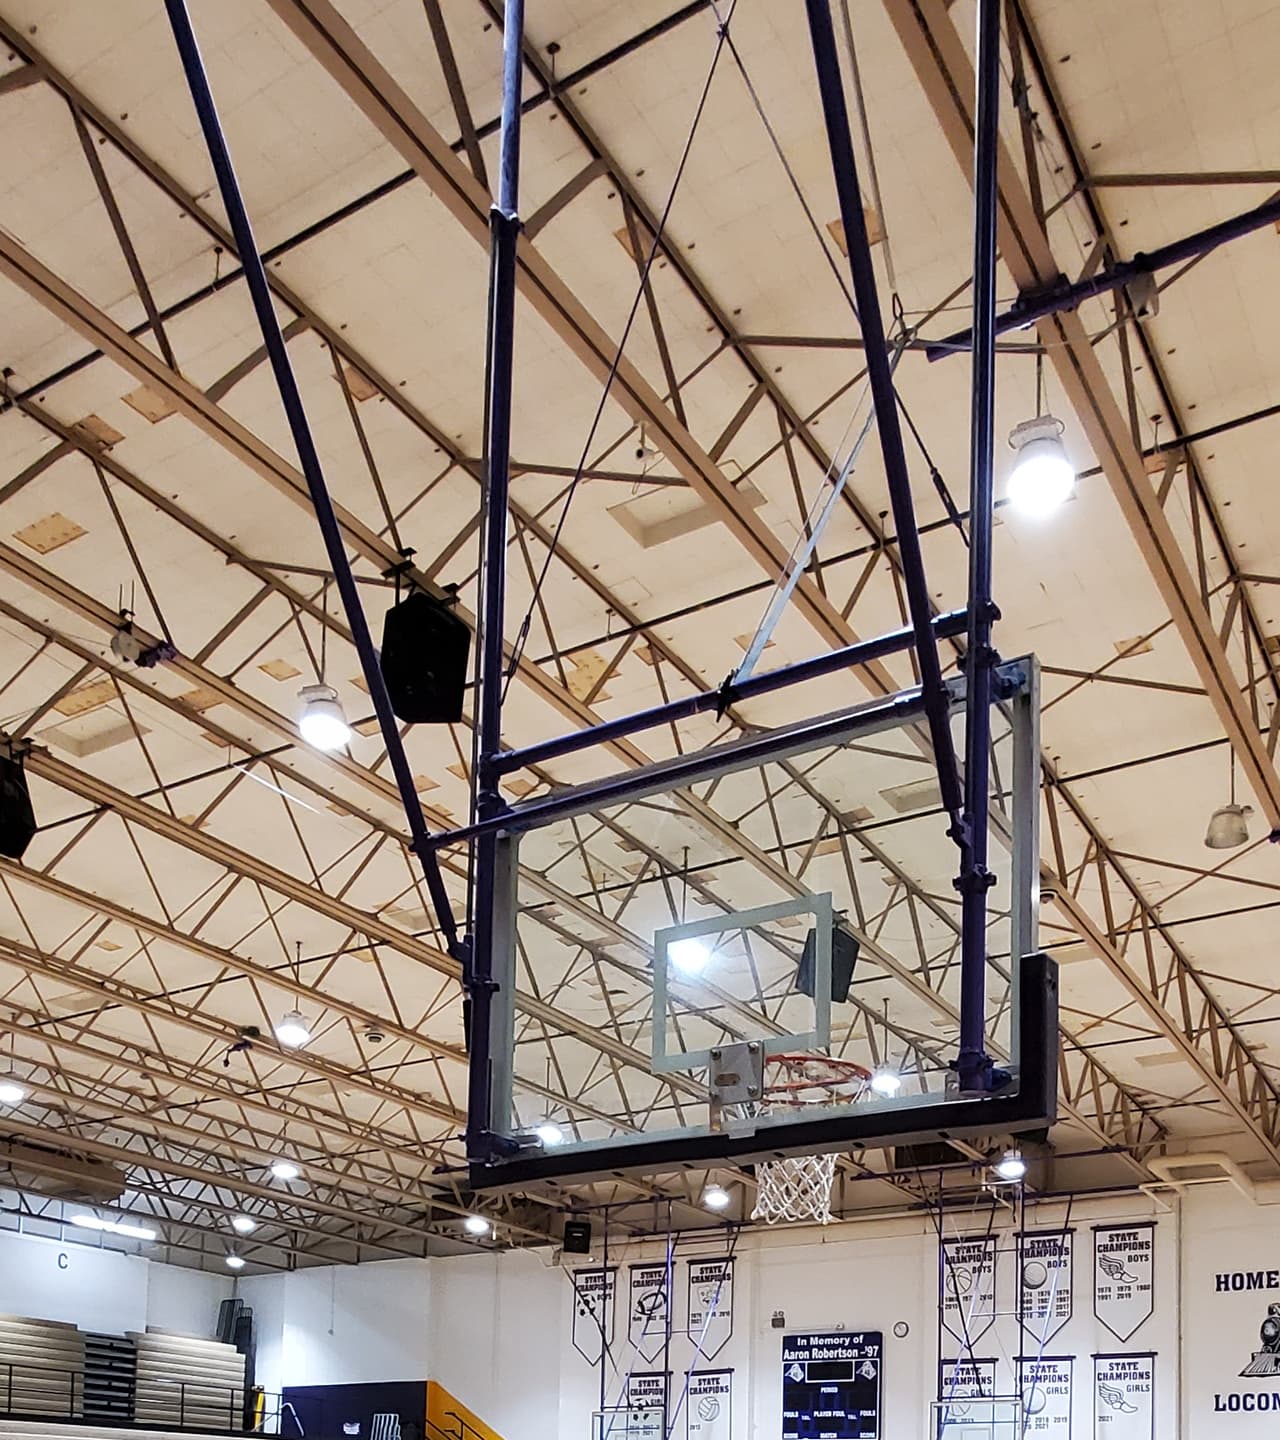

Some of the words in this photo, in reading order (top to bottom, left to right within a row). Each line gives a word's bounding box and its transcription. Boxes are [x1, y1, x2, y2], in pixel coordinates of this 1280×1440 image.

[1108, 1232, 1139, 1242] STATE
[1030, 1239, 1058, 1248] STATE
[1097, 1241, 1150, 1253] CHAMPIONS
[955, 1245, 982, 1255] STATE
[58, 1253, 68, 1269] C
[1127, 1254, 1149, 1262] BOYS
[700, 1265, 722, 1274] STATE
[640, 1271, 663, 1279] STATE
[1215, 1270, 1280, 1292] HOME
[797, 1337, 807, 1346] In
[810, 1336, 850, 1346] Memory
[853, 1334, 864, 1343] of
[784, 1349, 809, 1360] Aaron
[812, 1347, 858, 1359] Robertson
[1029, 1364, 1058, 1373] STATE
[1108, 1362, 1139, 1371] STATE
[1097, 1371, 1151, 1381] CHAMPIONS
[698, 1377, 720, 1386] STATE
[690, 1385, 729, 1395] CHAMPIONS
[1046, 1386, 1069, 1394] GIRLS
[1126, 1384, 1150, 1392] GIRLS
